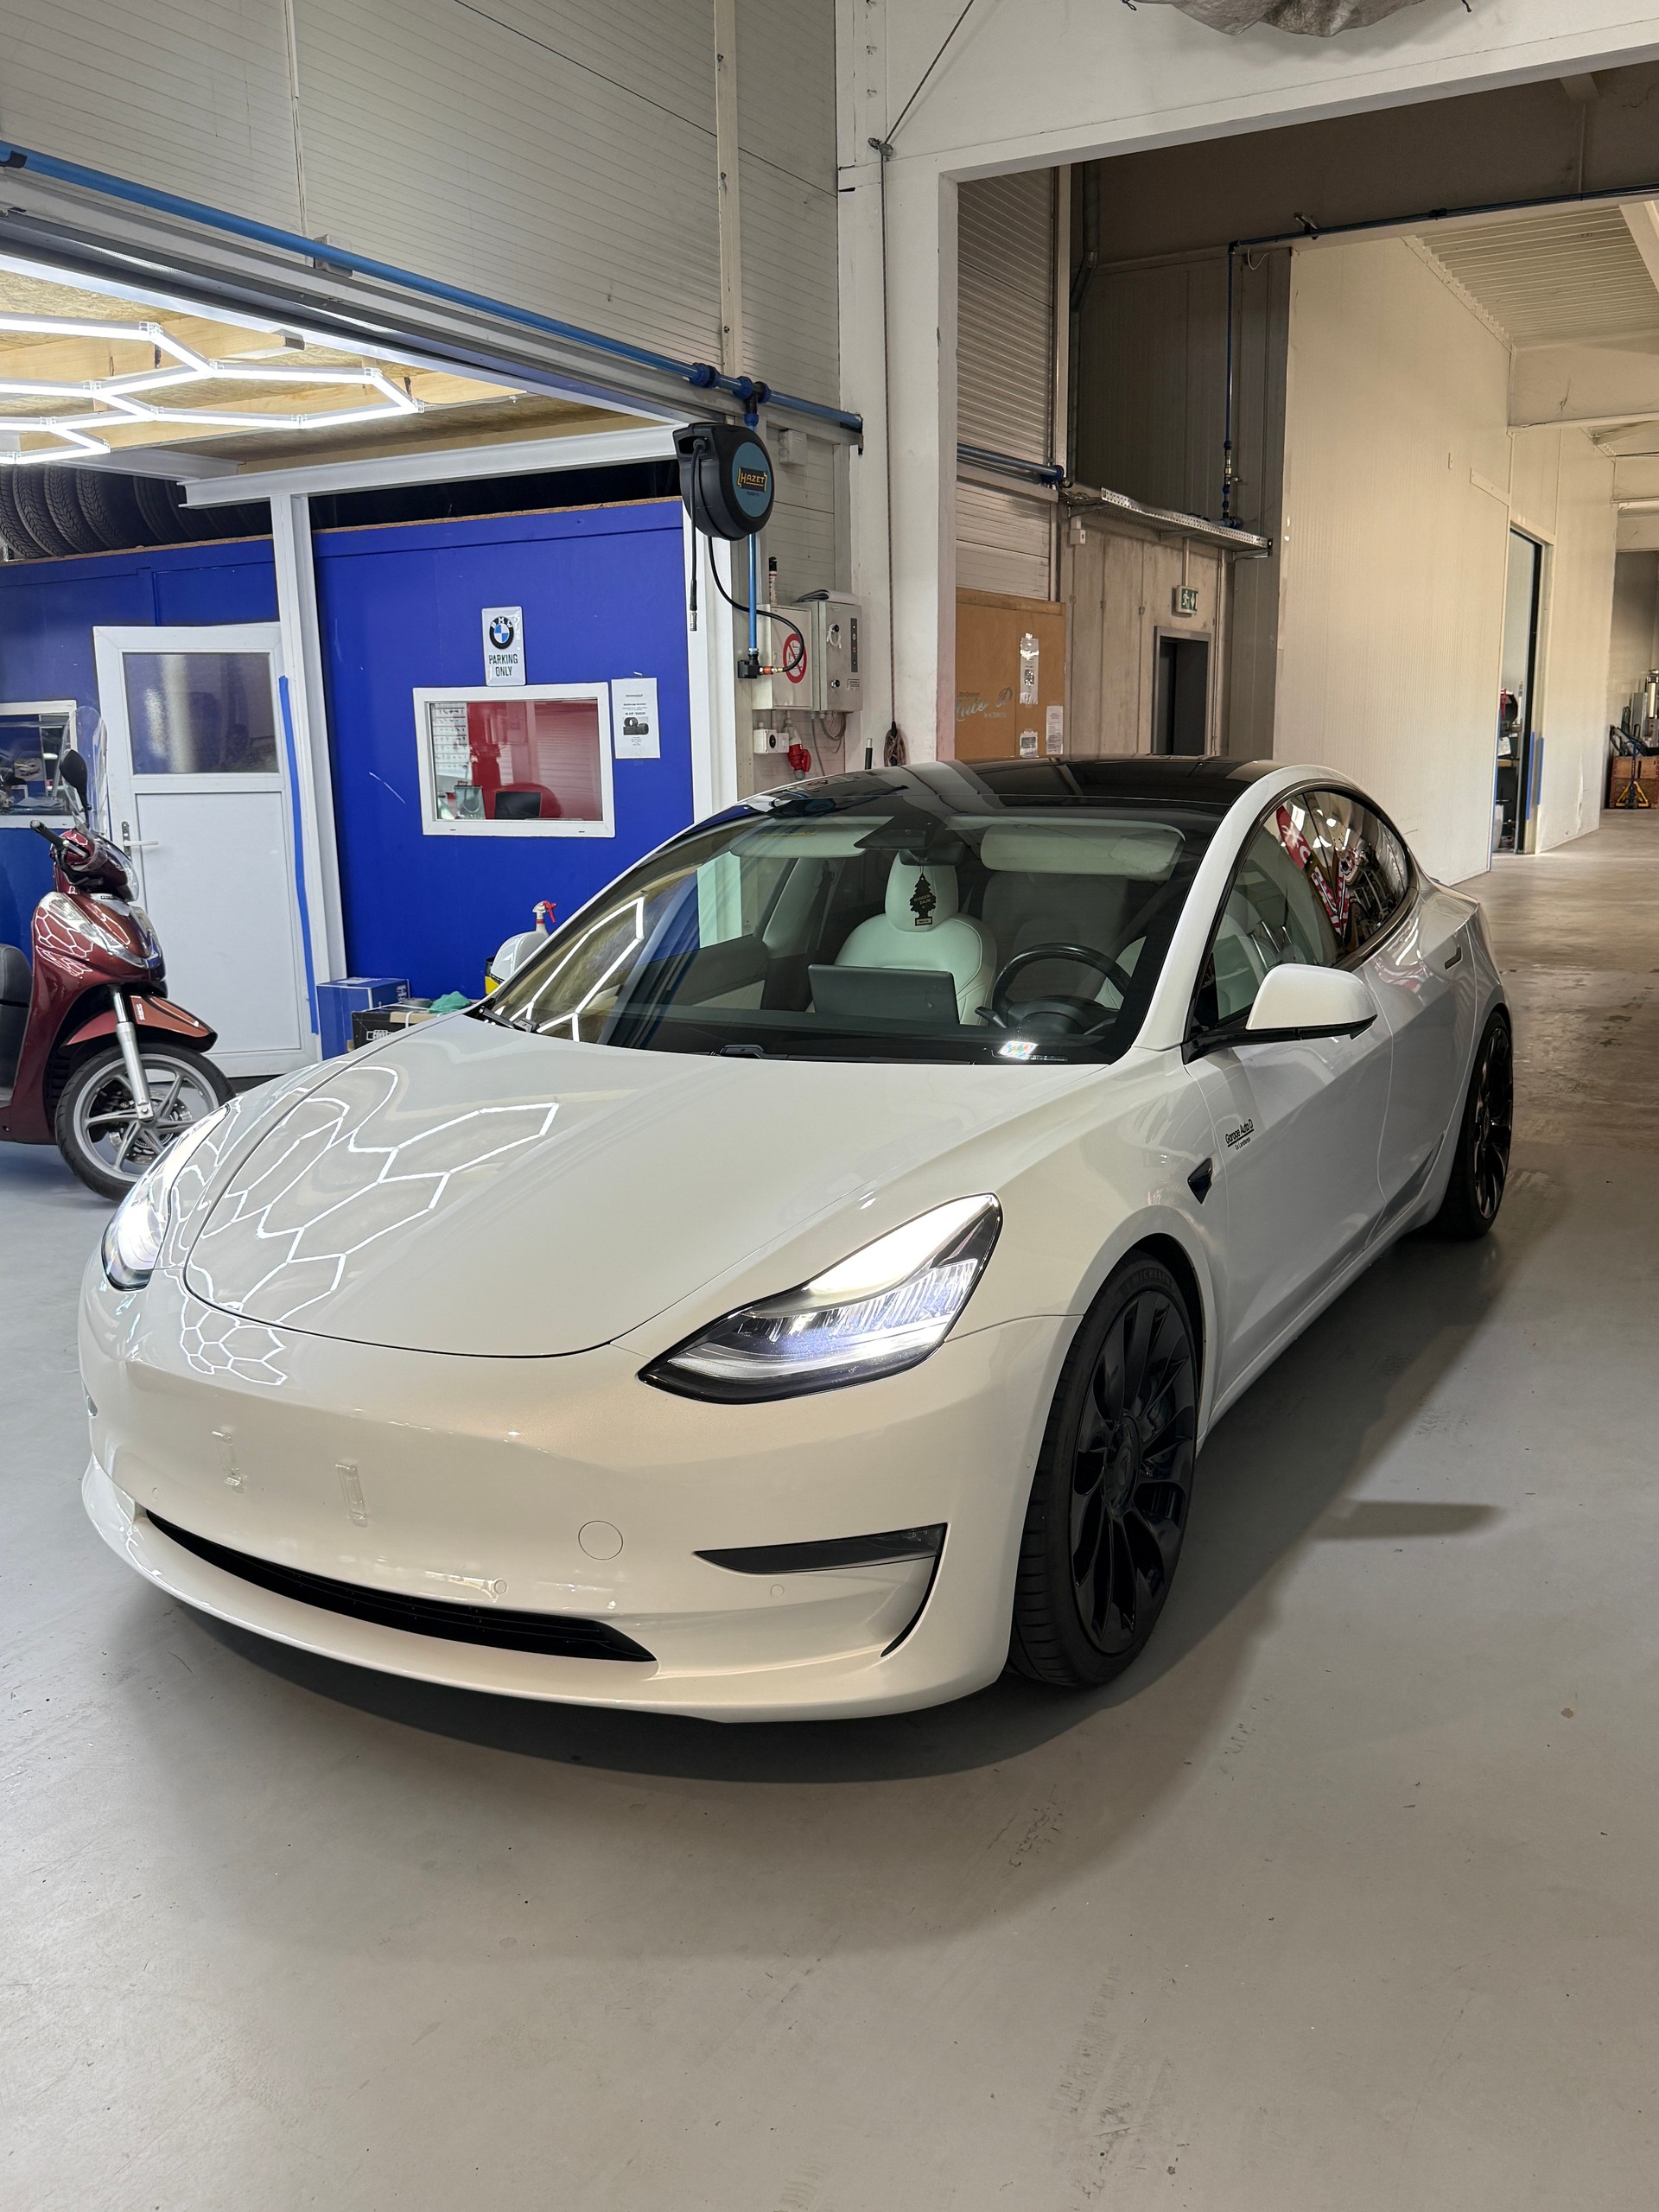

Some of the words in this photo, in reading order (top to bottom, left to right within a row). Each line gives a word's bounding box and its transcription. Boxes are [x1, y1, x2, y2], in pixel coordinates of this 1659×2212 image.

[740, 472, 766, 484] HAZET
[490, 616, 513, 628] BMW
[488, 654, 518, 664] PARKING
[495, 666, 512, 677] ONLY
[1225, 1128, 1241, 1145] Garage
[1133, 1268, 1173, 1288] MICHELIN
